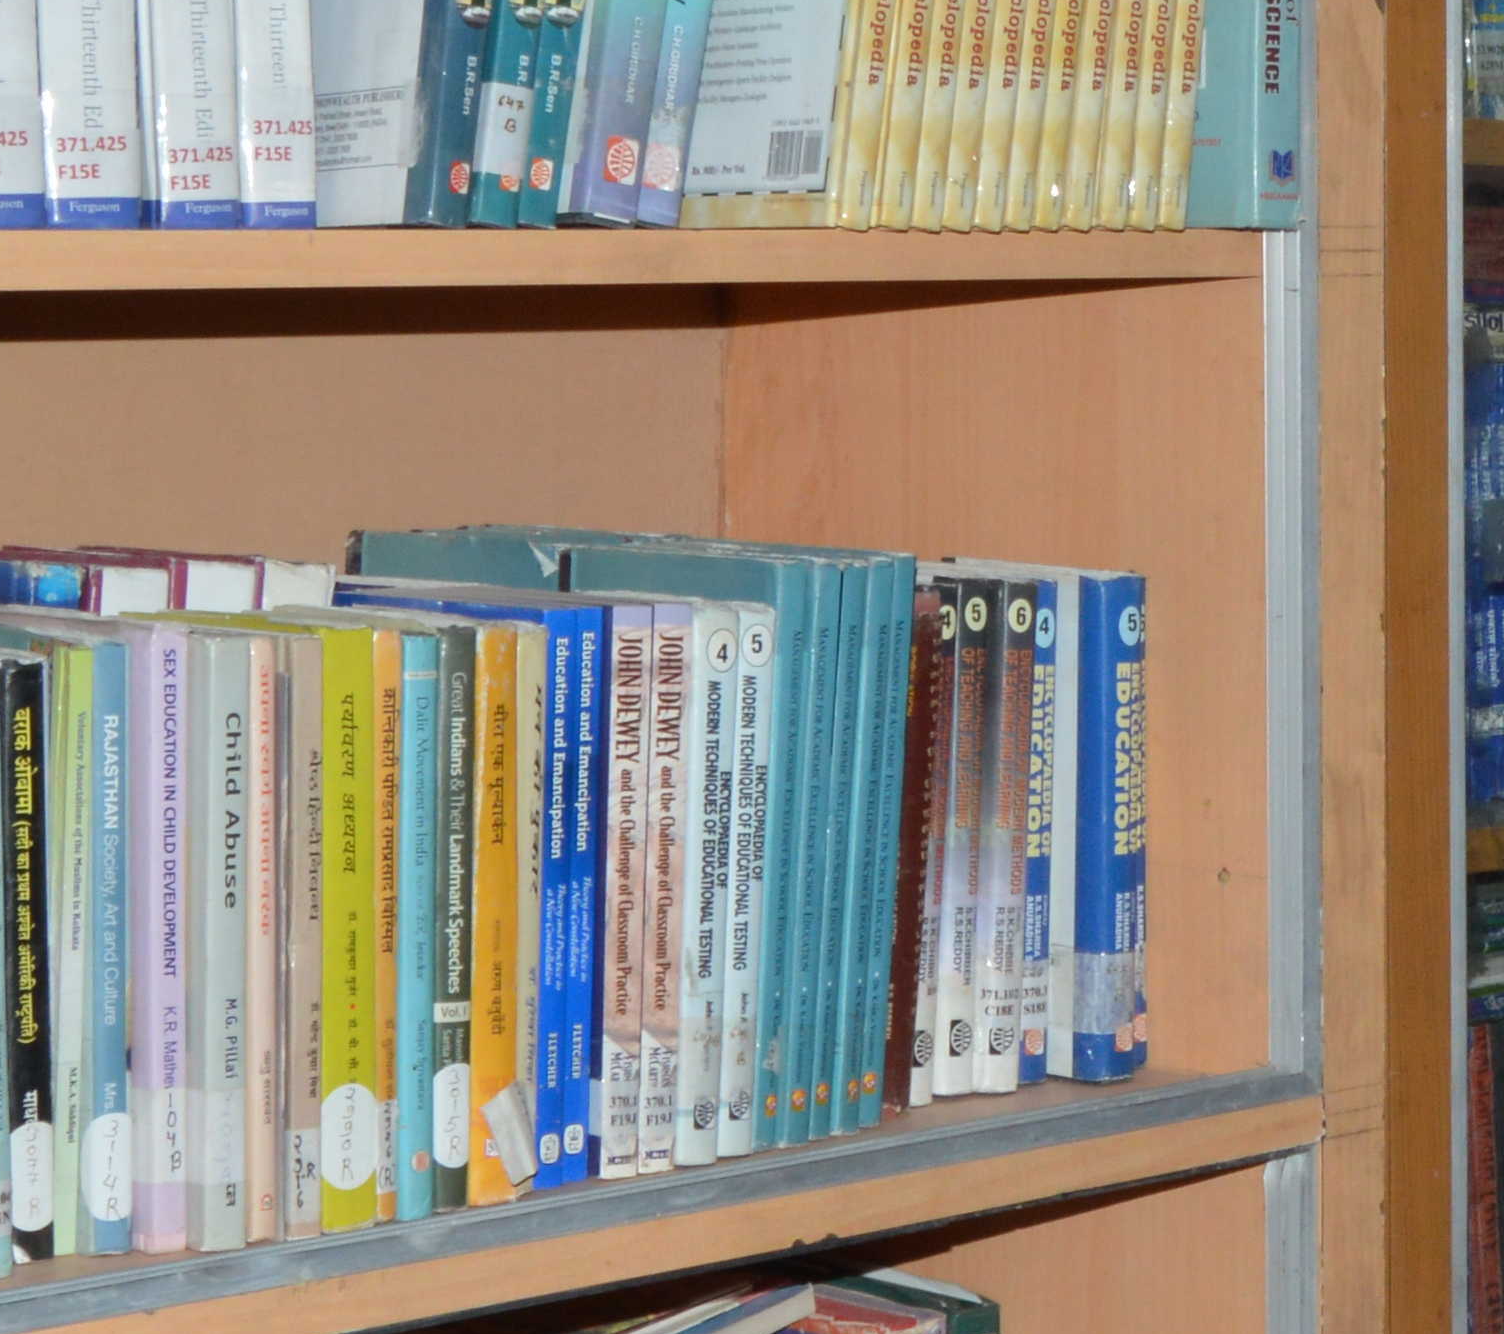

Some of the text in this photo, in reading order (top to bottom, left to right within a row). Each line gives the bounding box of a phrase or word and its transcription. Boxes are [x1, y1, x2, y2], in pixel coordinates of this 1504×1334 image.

[658, 634, 684, 689] JOHN
[656, 691, 682, 760] DEWEY
[661, 765, 674, 787] and
[662, 790, 675, 813] the
[162, 648, 177, 978] SEX EDUCATION IN CHILD DEVELOPMENT
[224, 712, 242, 910] Child Abuse
[656, 816, 676, 880] Challenge
[656, 897, 673, 960] Classroom
[654, 961, 672, 1011] Practice
